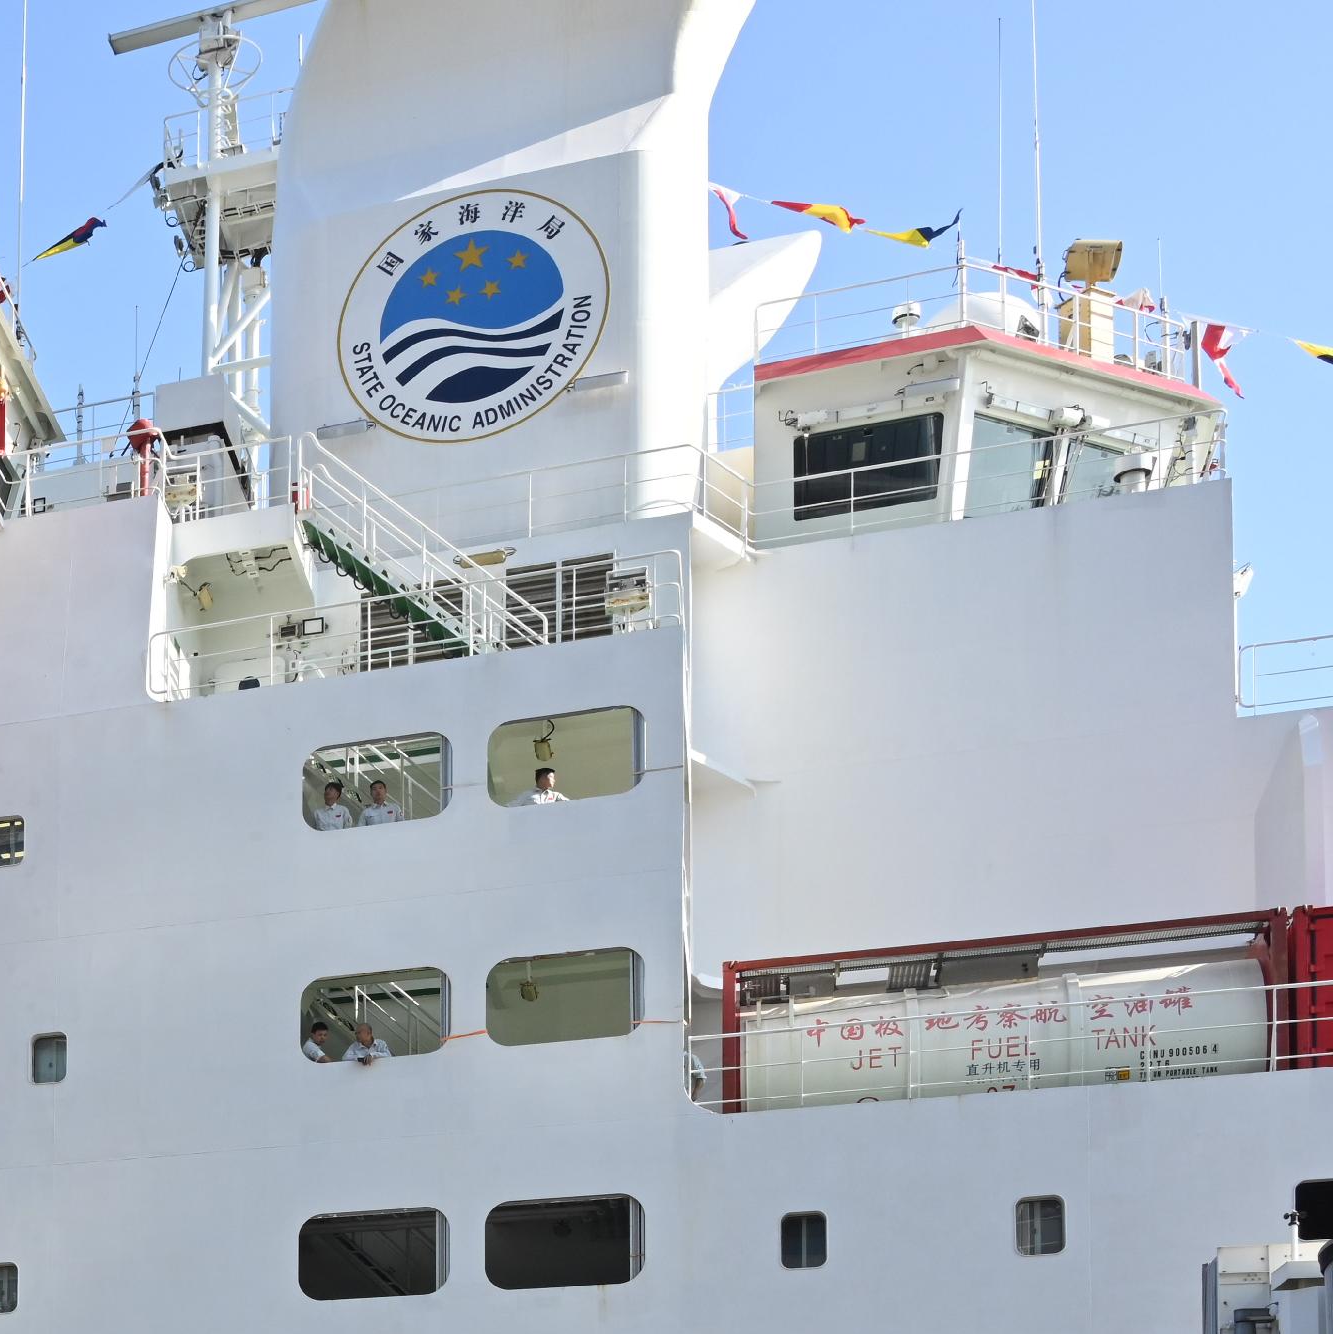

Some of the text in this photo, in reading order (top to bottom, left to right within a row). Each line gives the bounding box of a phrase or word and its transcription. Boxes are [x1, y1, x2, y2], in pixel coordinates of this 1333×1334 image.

[376, 200, 566, 277] 国家海洋局
[352, 295, 592, 433] STATE OCEANIC ADMINISTRATION
[851, 1024, 1156, 1071] JET FUEL TANK
[1169, 1046, 1207, 1058] 900506
[965, 1059, 1040, 1077] 直升机专用
[1166, 1067, 1197, 1077] PORTABLE
[1202, 1066, 1218, 1074] TANK
